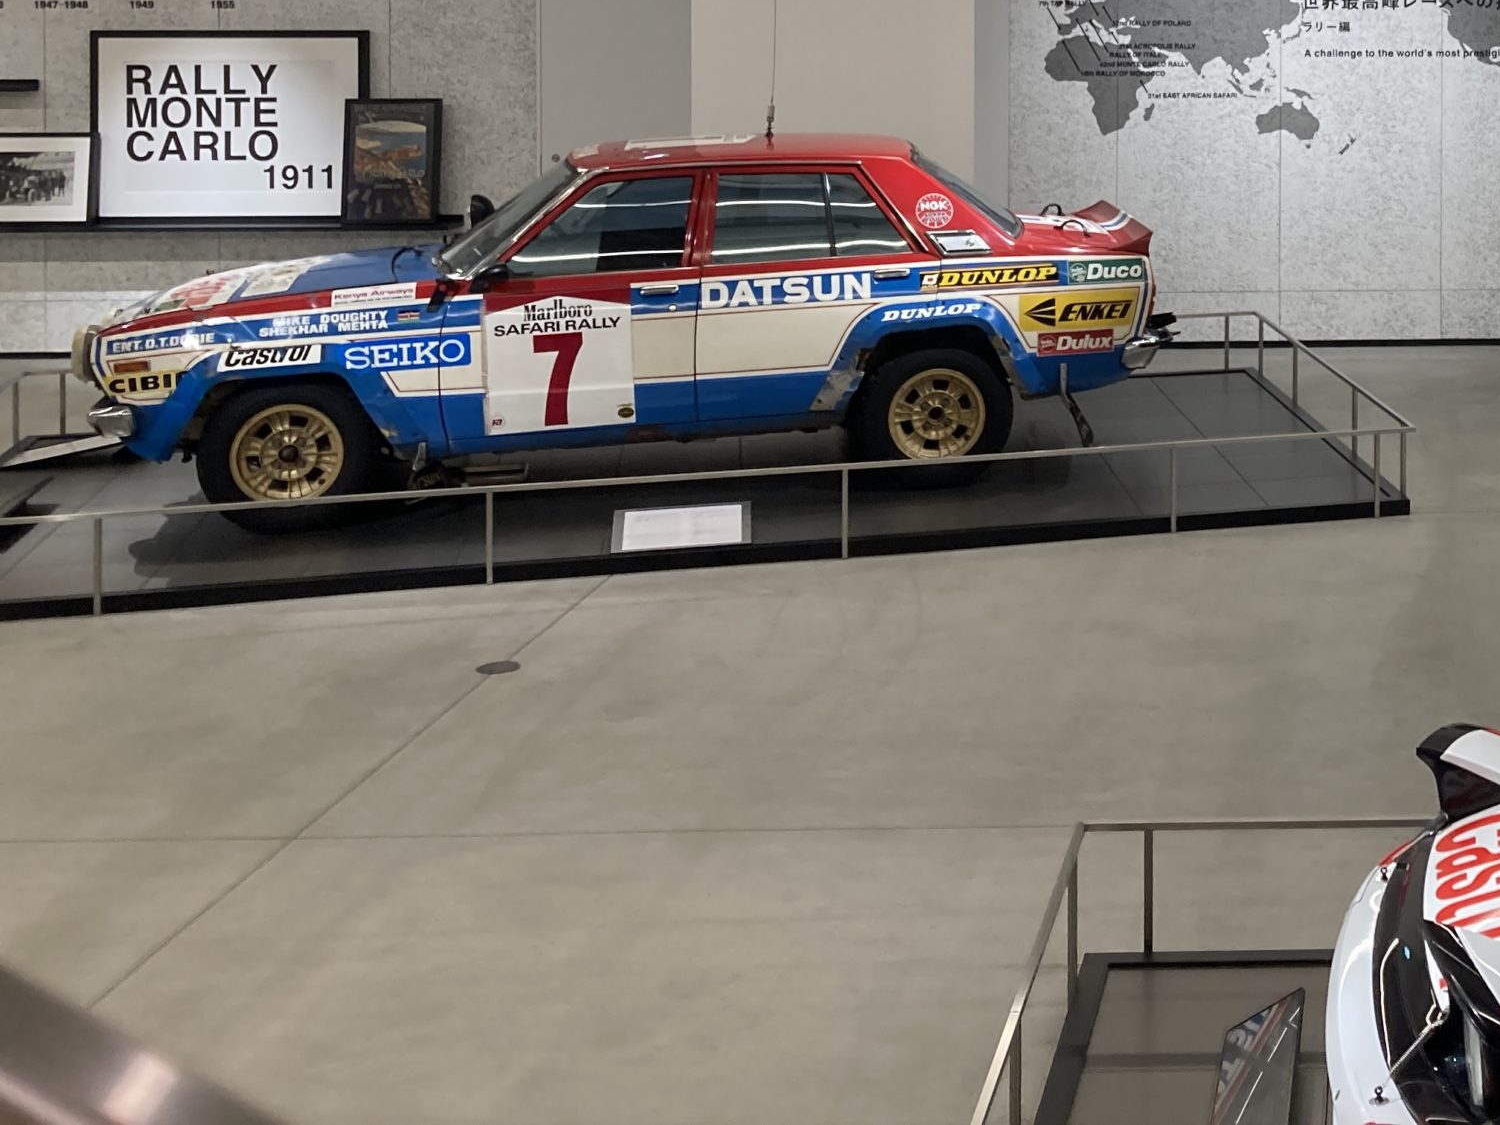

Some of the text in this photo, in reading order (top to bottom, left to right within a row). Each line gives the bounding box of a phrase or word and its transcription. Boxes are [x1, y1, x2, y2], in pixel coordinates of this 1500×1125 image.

[210, 0, 236, 10] 1955
[1303, 21, 1351, 33] ラリー編
[1304, 49, 1312, 59] A
[1314, 49, 1363, 61] challenge
[1365, 49, 1375, 59] to
[1378, 49, 1394, 59] the
[1396, 49, 1433, 59] world's
[1435, 50, 1461, 59] most
[126, 64, 279, 95] RALLY
[126, 96, 279, 128] MONTE
[126, 130, 280, 162] CARLO
[263, 165, 334, 190] 1911
[919, 200, 949, 212] NGK
[939, 266, 1058, 286] DUNLOP
[1086, 263, 1143, 280] Duco
[333, 292, 368, 302] Kenya
[370, 287, 414, 298] Airways
[699, 272, 872, 309] DATSUN
[272, 310, 388, 327] MIKE DOUGHTY
[523, 298, 593, 322] Marlboro
[880, 303, 981, 323] DUNLOP
[1058, 299, 1134, 323] ENKEI
[258, 320, 389, 338] SHEKHAR MEHTA
[493, 316, 622, 337] SAFARI RALLY
[1055, 334, 1113, 352] Dulux
[224, 344, 313, 367] Castrol
[344, 339, 466, 371] SEIKO
[532, 331, 584, 427] 7
